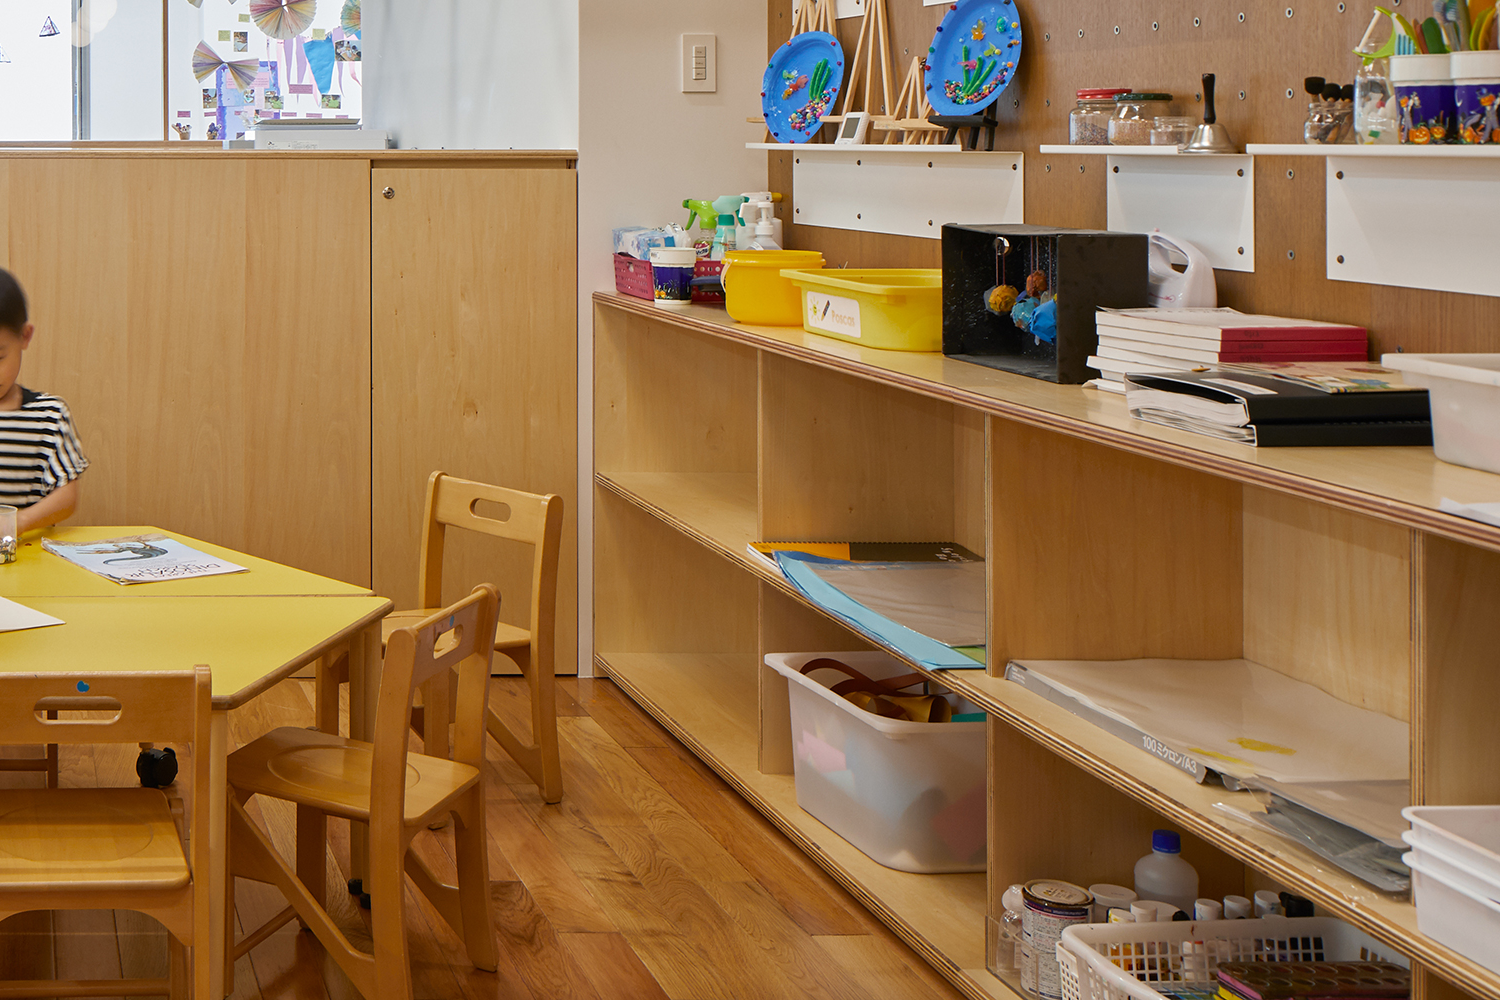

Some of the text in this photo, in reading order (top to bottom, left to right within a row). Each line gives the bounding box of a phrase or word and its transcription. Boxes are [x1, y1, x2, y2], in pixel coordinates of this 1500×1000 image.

[831, 309, 856, 327] Poscas
[1142, 735, 1197, 774] 100ミクロン/A3
